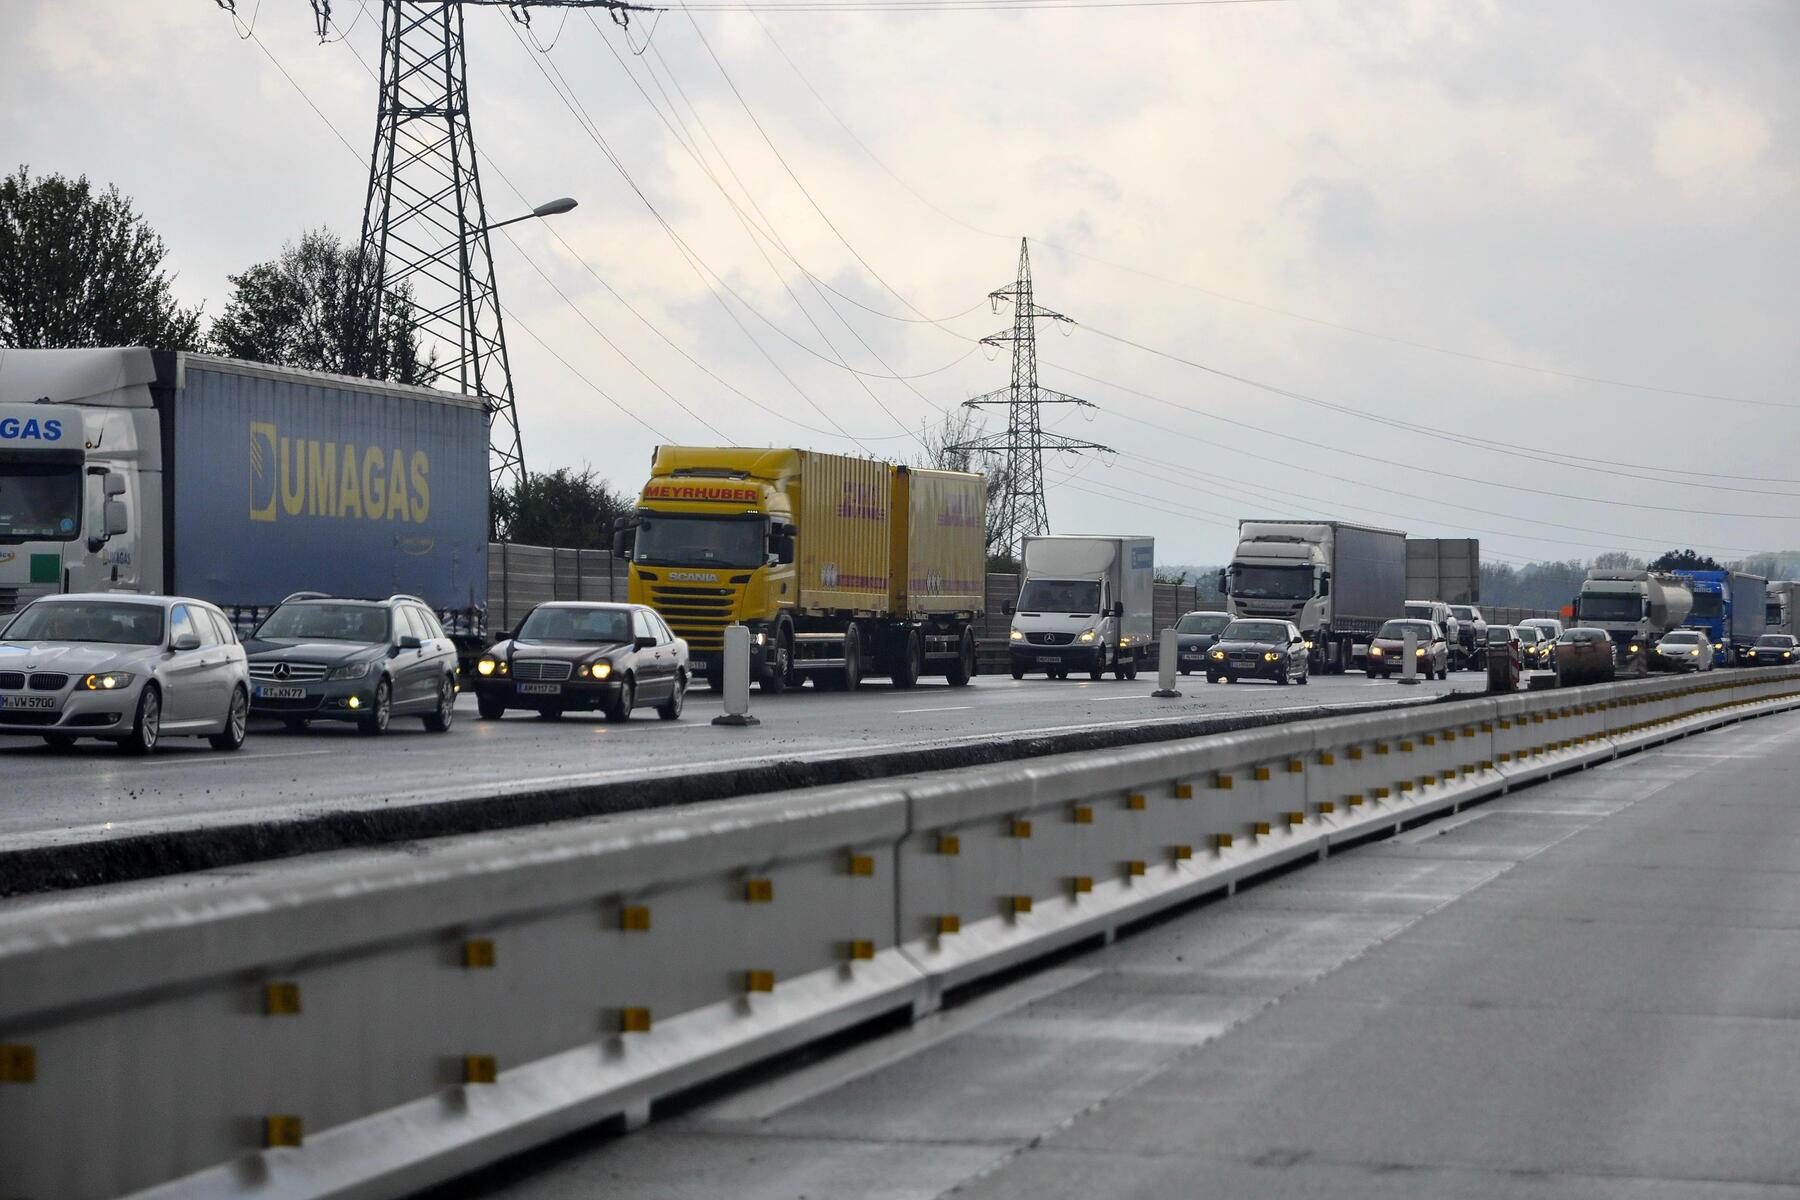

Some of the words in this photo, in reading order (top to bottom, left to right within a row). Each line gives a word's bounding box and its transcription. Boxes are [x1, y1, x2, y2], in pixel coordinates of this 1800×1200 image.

[645, 486, 757, 500] MEYRHUBER
[668, 572, 718, 582] SCANIA
[29, 697, 54, 708] 5700
